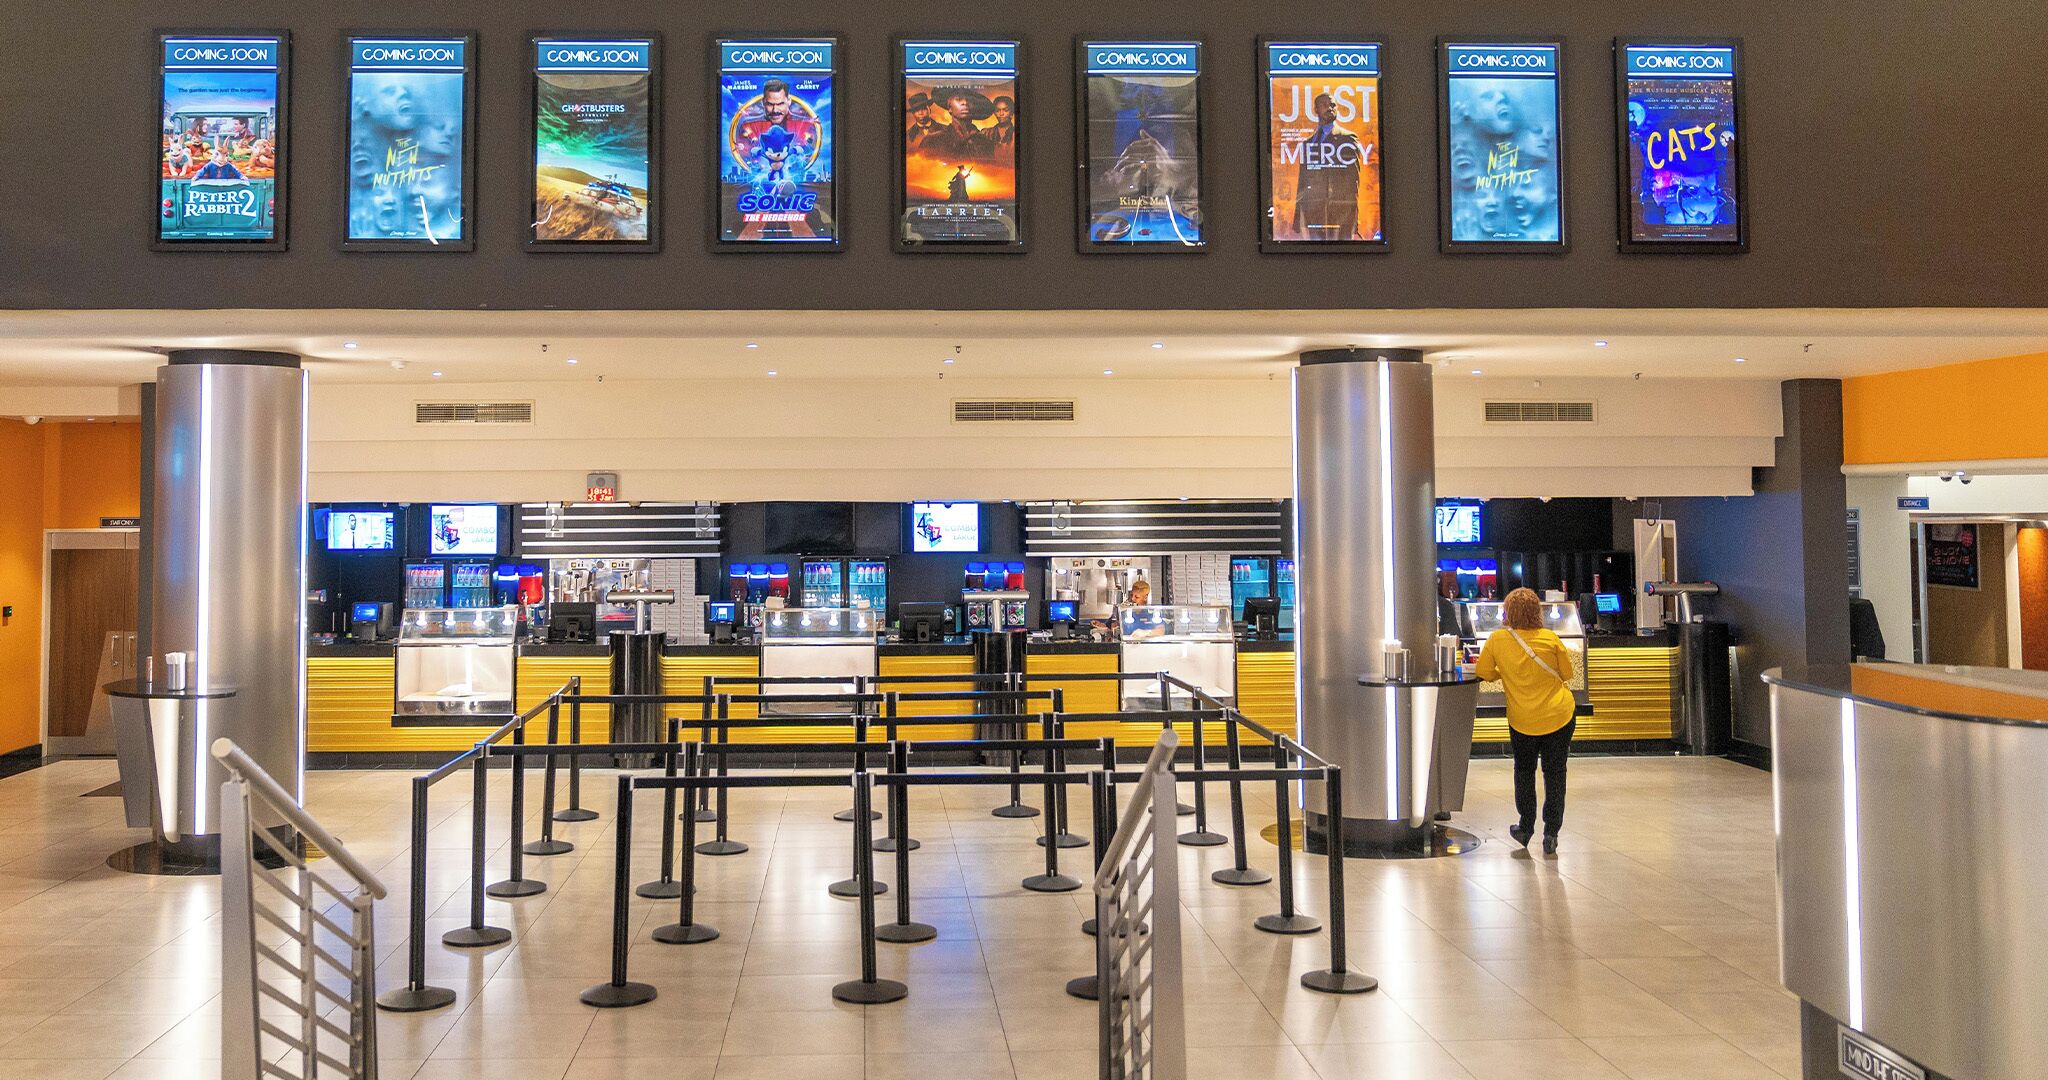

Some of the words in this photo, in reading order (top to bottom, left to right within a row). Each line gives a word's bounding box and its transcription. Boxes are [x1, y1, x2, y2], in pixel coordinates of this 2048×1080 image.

[174, 48, 228, 61] COMING
[229, 48, 268, 61] SOON
[362, 48, 415, 61] COMING
[417, 48, 455, 61] SOON
[547, 50, 601, 63] COMING
[602, 50, 639, 63] SOON
[731, 50, 784, 64] COMING
[785, 50, 822, 64] SOON
[914, 51, 967, 65] COMING
[969, 51, 1006, 65] SOON
[1097, 52, 1149, 65] COMING
[1150, 52, 1187, 65] SOON
[1278, 53, 1331, 66] COMING
[1332, 53, 1368, 66] SOON
[1457, 54, 1509, 67] COMING
[1511, 54, 1546, 67] SOON
[1636, 55, 1687, 68] COMING
[1688, 55, 1723, 68] SOON
[1278, 84, 1376, 123] JUST
[1280, 142, 1373, 165] MERCY
[1647, 122, 1716, 169] CATS
[385, 141, 420, 171] NEW
[1487, 145, 1519, 175] NEW
[372, 165, 442, 191] MUTANTS
[1475, 168, 1539, 192] MUTANTS
[183, 203, 243, 217] RABBIT
[238, 189, 257, 217] 2
[188, 190, 239, 204] PETER
[739, 193, 817, 212] SONIC
[744, 213, 760, 222] THE
[761, 213, 806, 222] HEDGEHOG
[917, 207, 1004, 216] HARRIET
[550, 513, 560, 532] 2
[698, 512, 711, 532] 3
[916, 513, 928, 533] 4
[1446, 508, 1458, 527] 7
[463, 526, 496, 534] COMBO
[1848, 1045, 1871, 1072] MIND
[1873, 1058, 1890, 1080] THE
